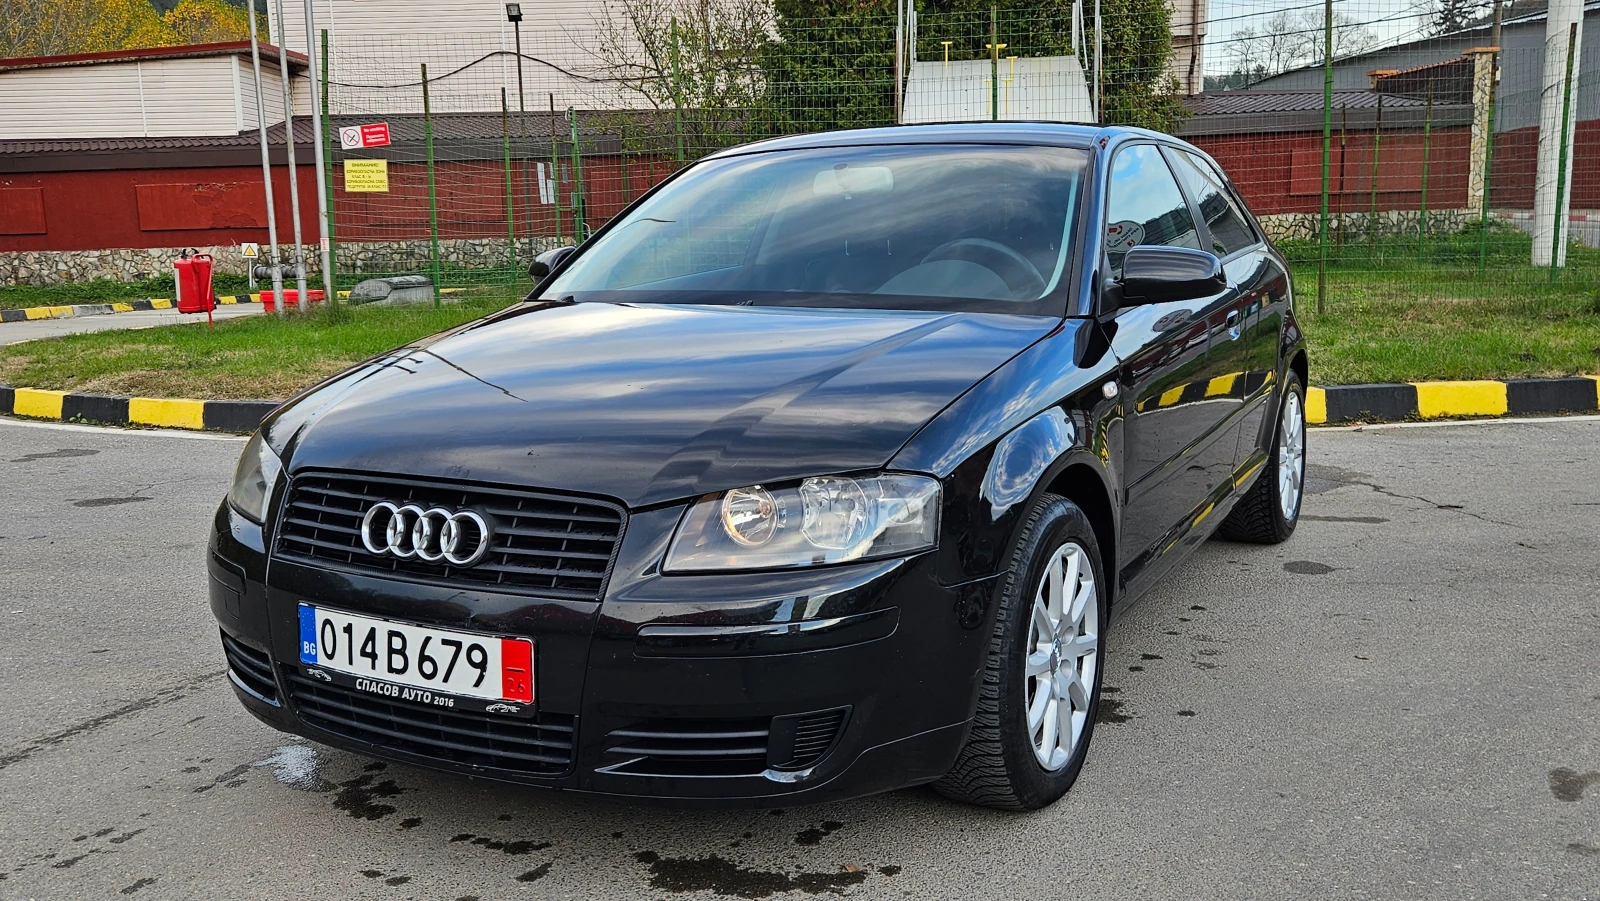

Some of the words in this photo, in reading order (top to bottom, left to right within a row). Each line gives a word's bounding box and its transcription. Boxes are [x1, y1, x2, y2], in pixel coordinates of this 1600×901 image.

[303, 641, 317, 656] BG
[320, 618, 488, 688] 014B679
[355, 678, 399, 697] СПАСОВ
[401, 687, 432, 704] АУТО
[433, 696, 454, 707] 2016
